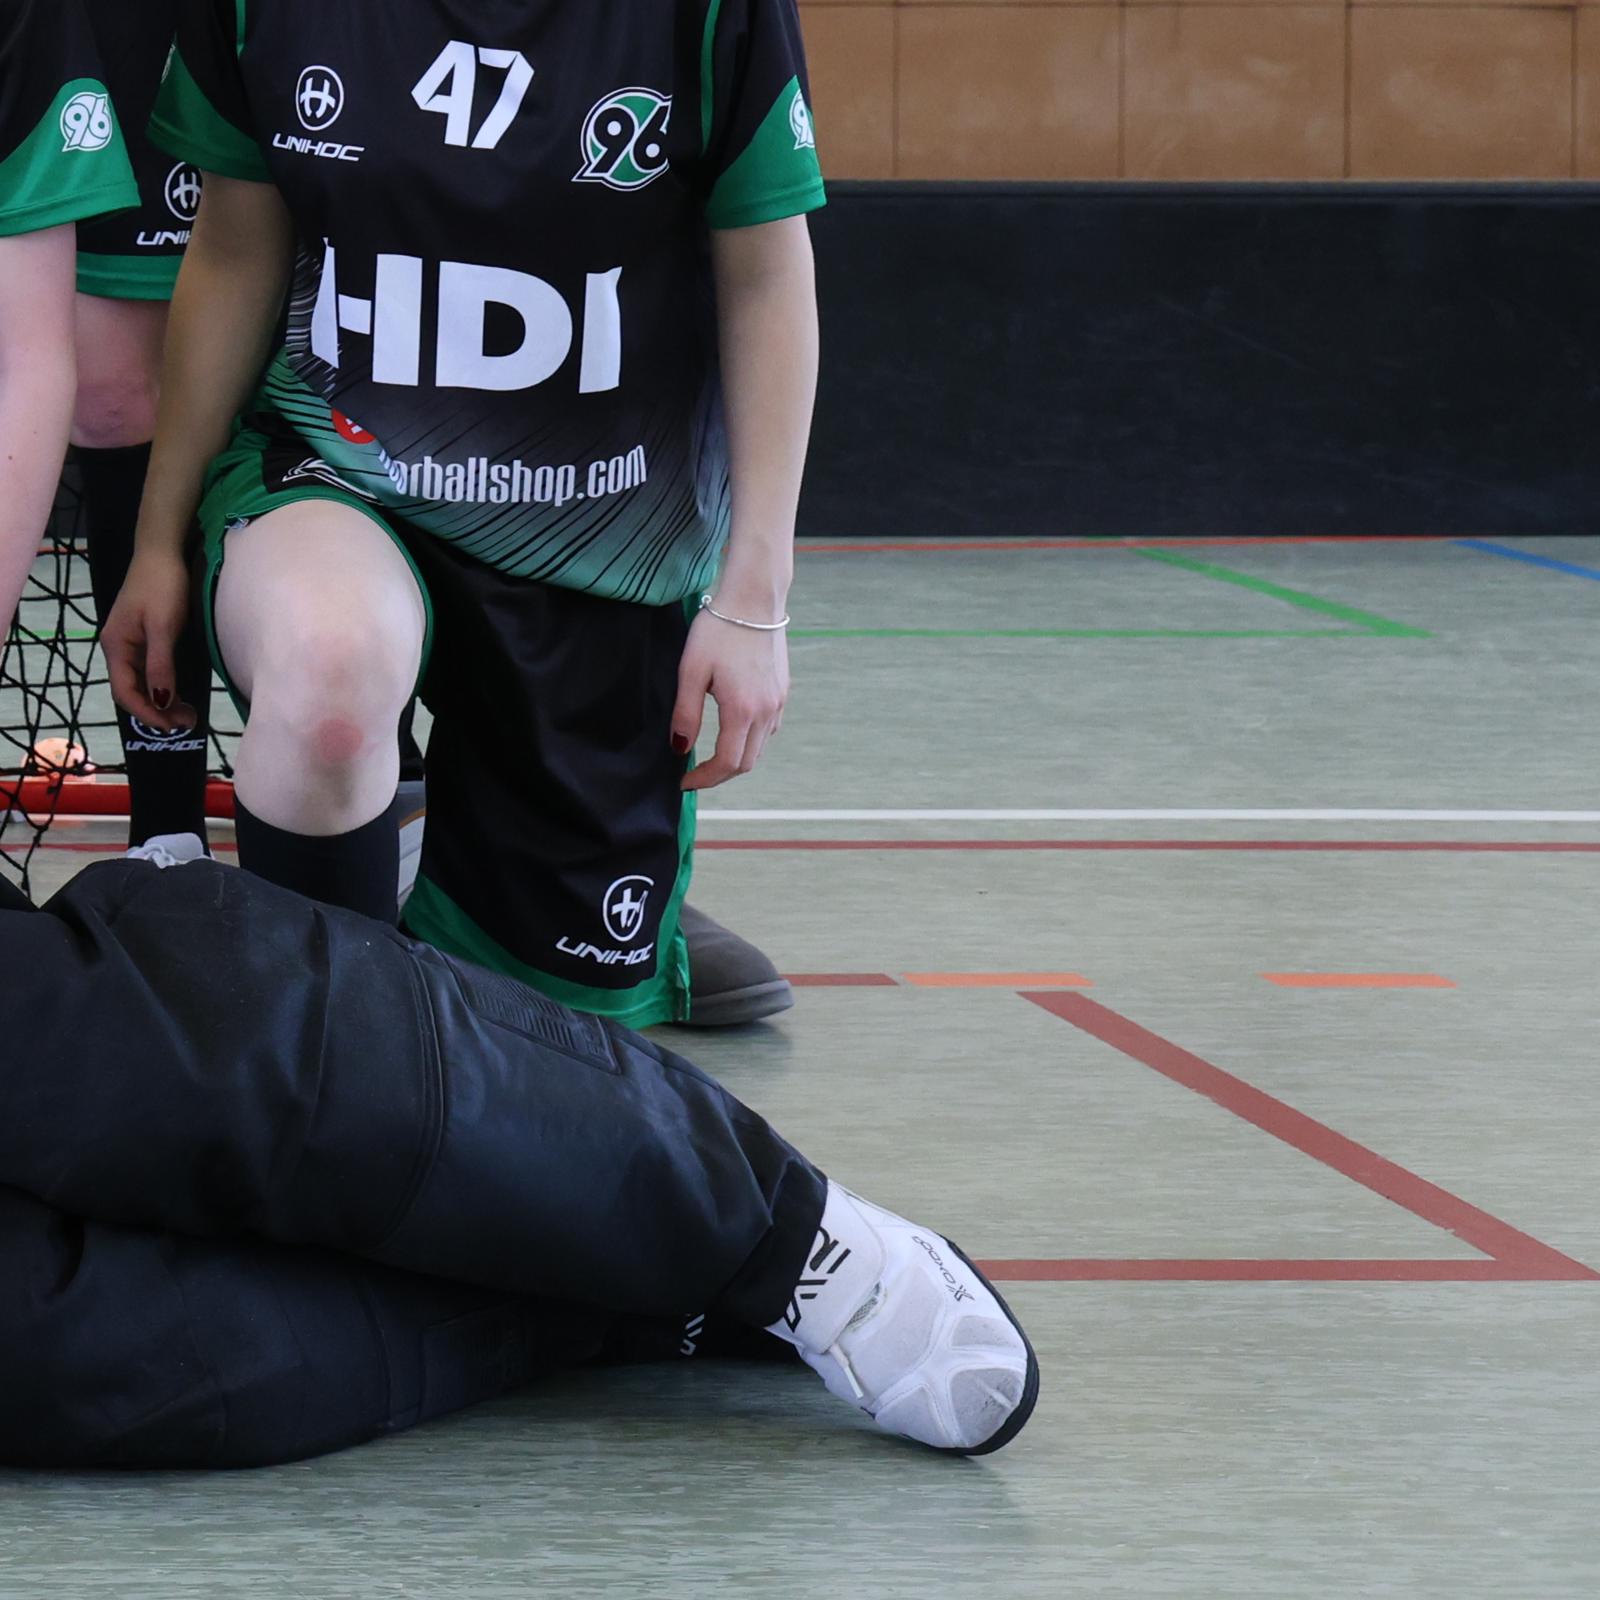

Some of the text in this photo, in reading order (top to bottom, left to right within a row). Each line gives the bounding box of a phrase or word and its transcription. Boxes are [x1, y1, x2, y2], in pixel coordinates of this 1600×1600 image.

[62, 97, 111, 146] 96
[411, 40, 535, 149] 47
[272, 133, 365, 162] UNIHOC
[582, 96, 669, 179] 96
[311, 236, 622, 394] HDI
[126, 739, 206, 752] UNIHOC
